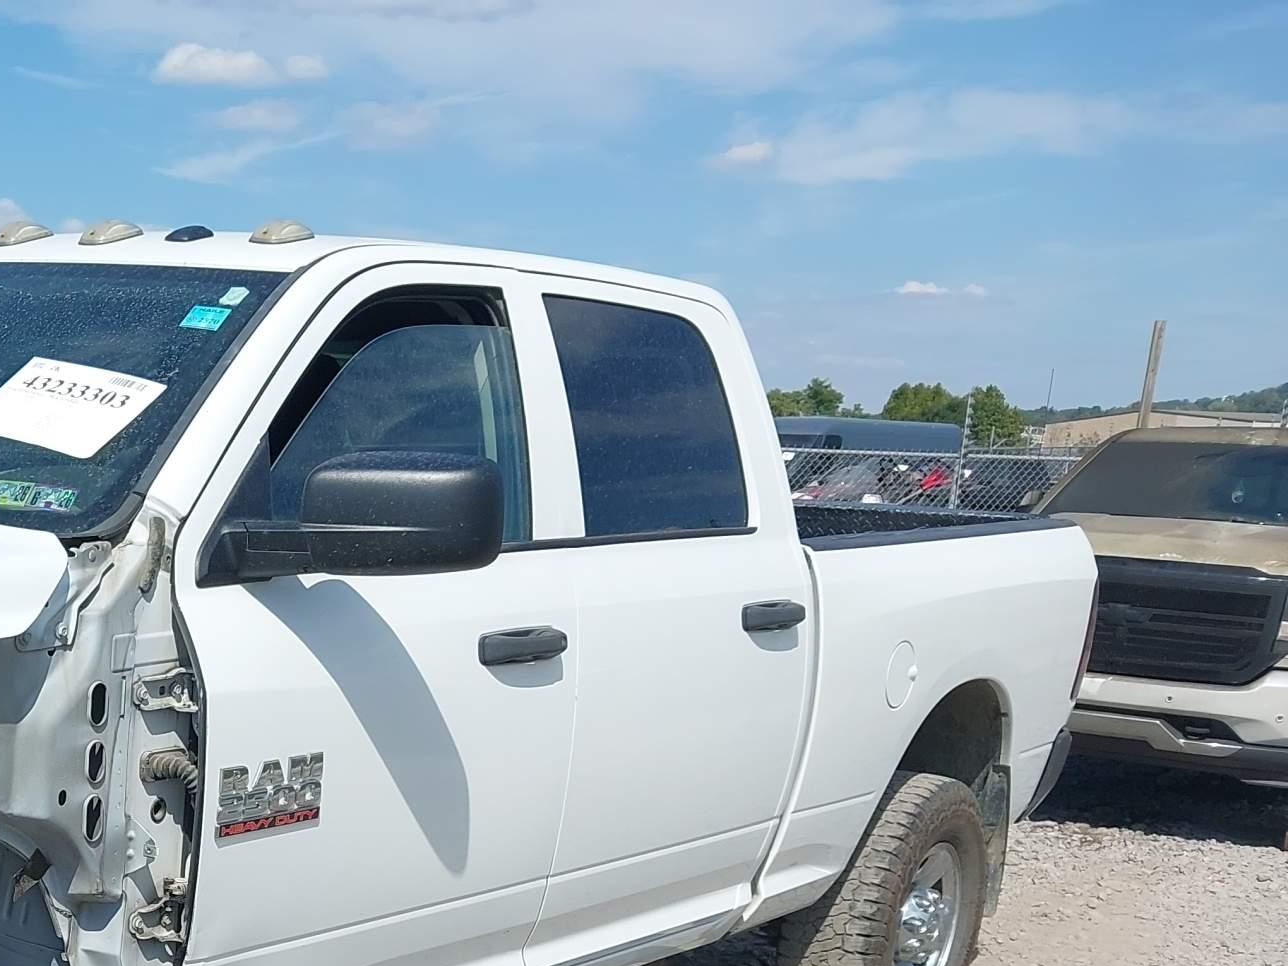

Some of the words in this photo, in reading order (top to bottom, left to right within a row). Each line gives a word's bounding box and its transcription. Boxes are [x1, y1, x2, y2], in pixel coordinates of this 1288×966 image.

[22, 375, 131, 408] 43233303
[219, 752, 324, 794] RAM
[216, 778, 323, 825] 2500
[220, 816, 275, 837] HEAVY
[274, 808, 318, 826] DUTY
